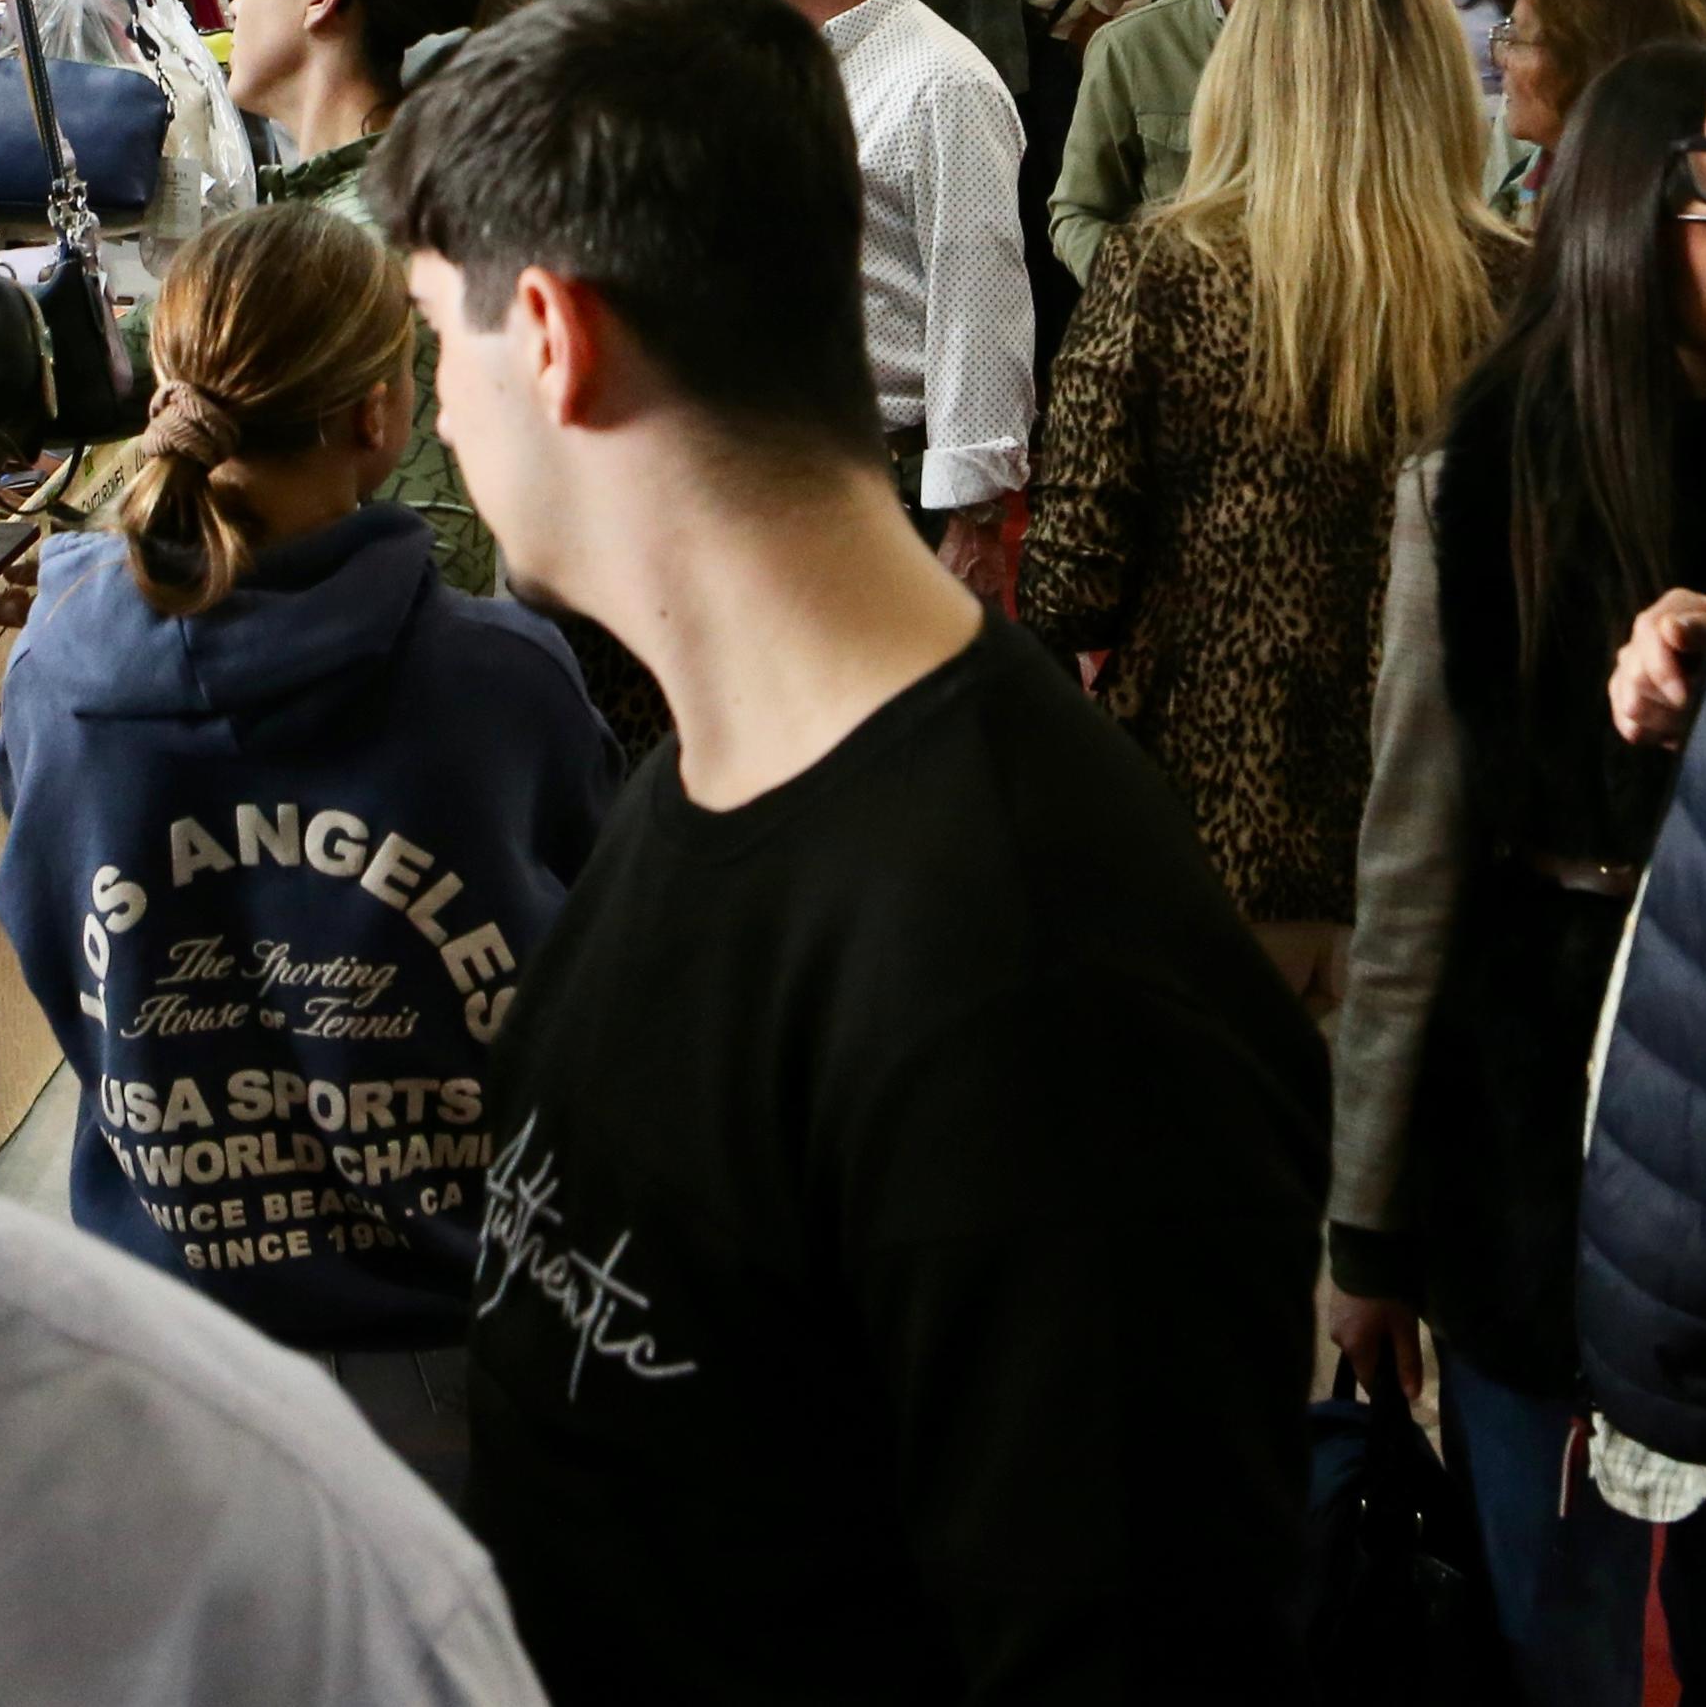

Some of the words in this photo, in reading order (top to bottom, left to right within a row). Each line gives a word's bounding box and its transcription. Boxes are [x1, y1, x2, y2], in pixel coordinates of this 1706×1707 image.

[80, 864, 148, 1032] LOS
[169, 803, 518, 1046] ANGELES
[155, 933, 235, 985] The
[240, 939, 399, 1007] Sporting
[119, 993, 250, 1041] House
[292, 995, 420, 1040] Tennis
[100, 1073, 215, 1135] USA
[227, 1068, 484, 1133] SPORTS
[136, 1131, 326, 1188] WORLD
[184, 1229, 312, 1271] SINCE
